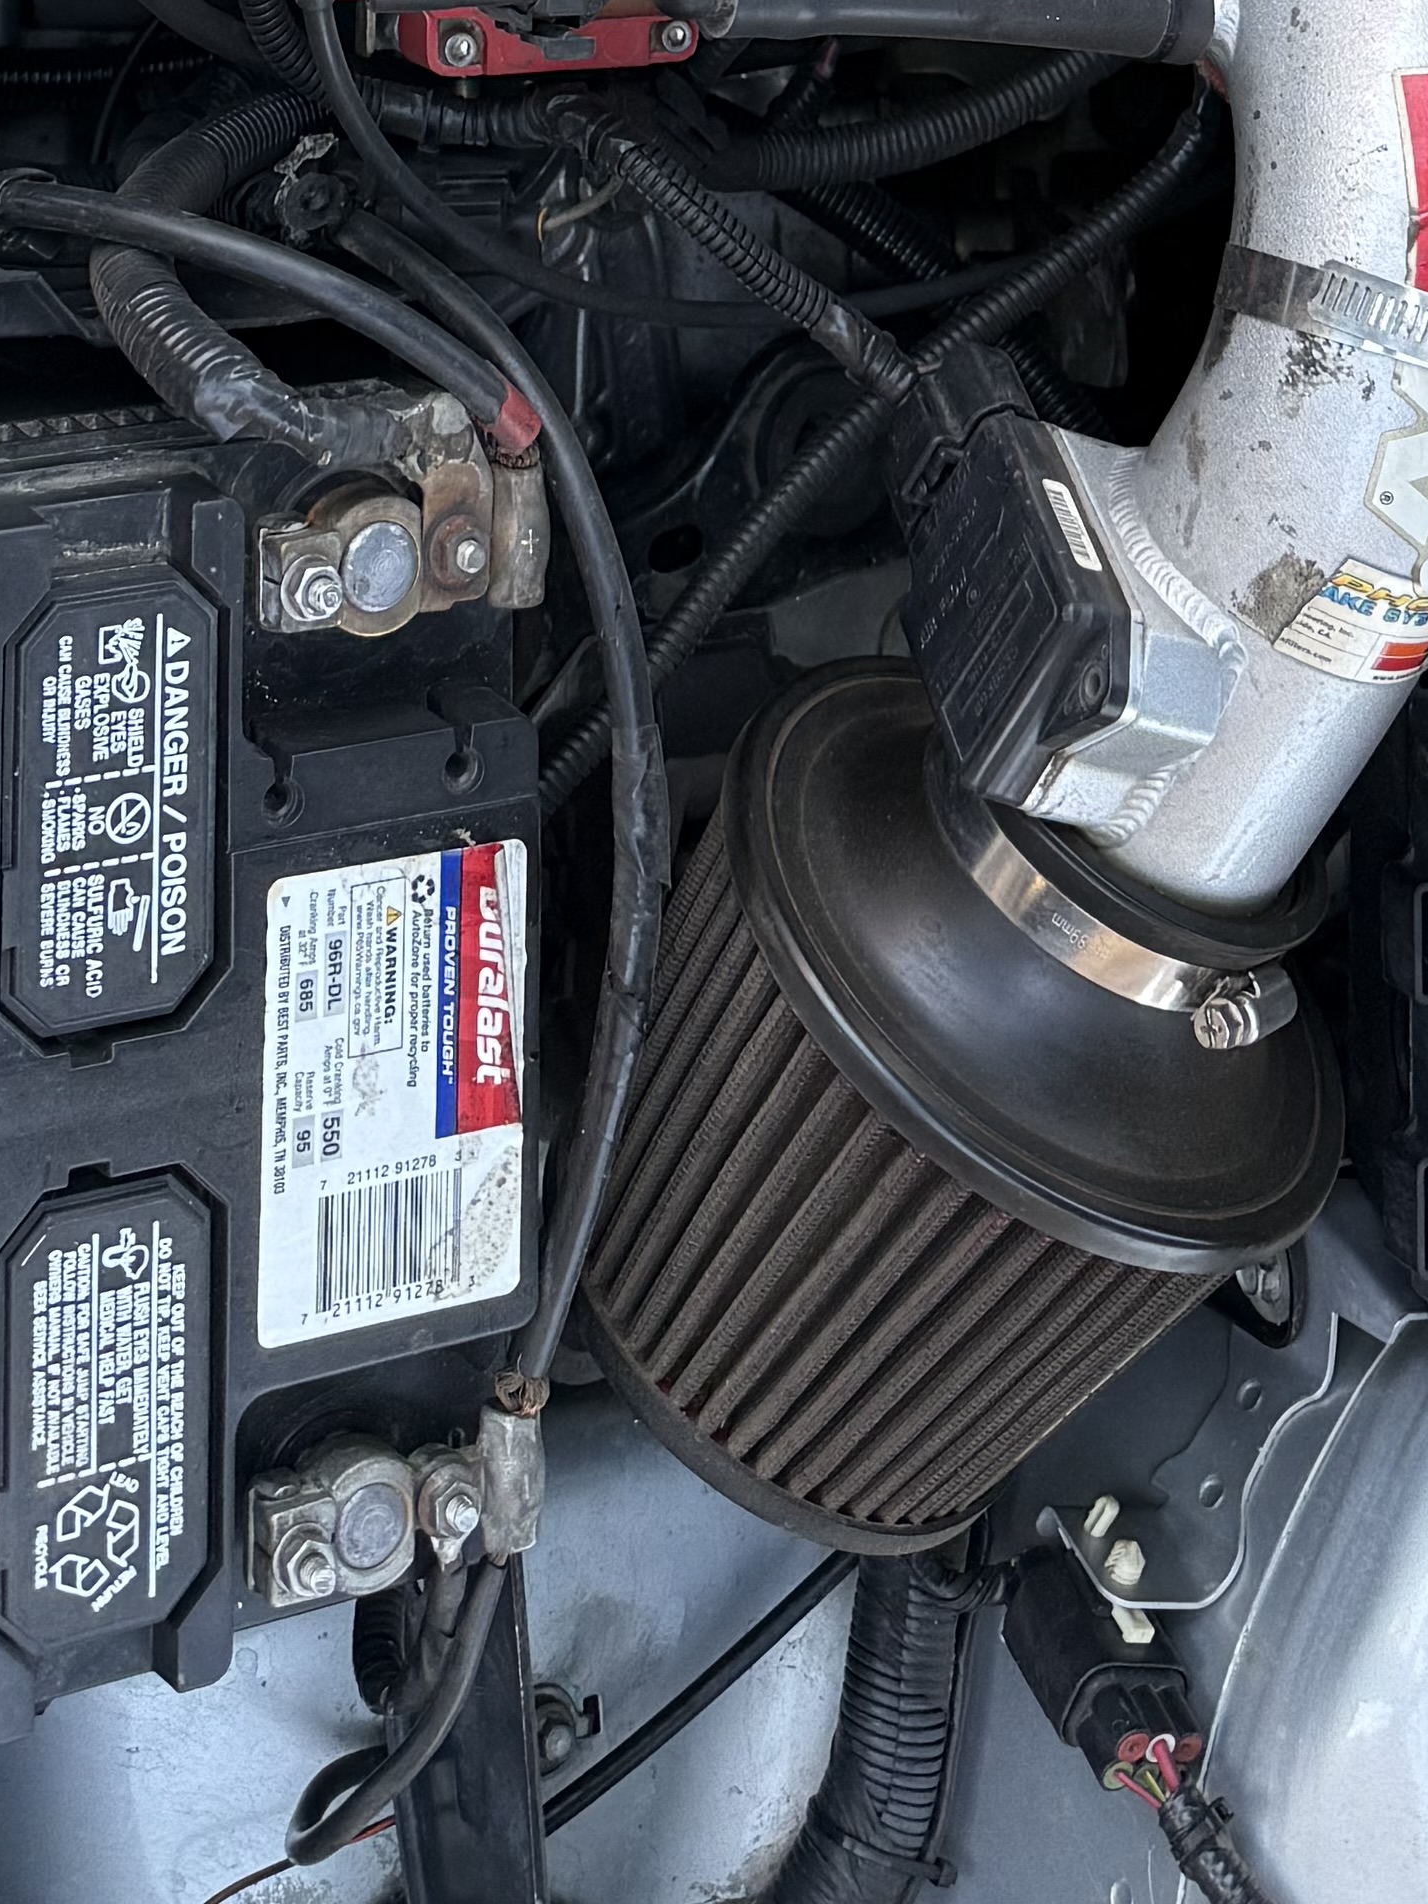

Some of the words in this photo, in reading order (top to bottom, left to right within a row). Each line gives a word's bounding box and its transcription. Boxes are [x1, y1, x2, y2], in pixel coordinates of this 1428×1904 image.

[58, 636, 73, 662] CAN
[57, 665, 72, 705] CAUSE
[74, 675, 92, 730] GASES
[41, 698, 57, 743] INJURY
[92, 673, 111, 762] EXPLOSIVE
[109, 711, 126, 754] EYES
[162, 660, 189, 797] DANGER
[56, 708, 72, 777] BLINDNESS
[127, 708, 144, 768] SHIELD
[40, 798, 56, 864] SMOKING
[56, 796, 71, 852] FLAMES
[72, 794, 87, 851] SPARKS
[88, 806, 105, 835] NO
[40, 883, 55, 938] SEVERE
[72, 877, 87, 908] CAN
[161, 832, 187, 956] POISON
[56, 880, 70, 959] BLINDNESS
[87, 874, 105, 954] SULFURIC
[337, 906, 348, 925] Part
[420, 908, 435, 948] Return
[72, 911, 86, 959] CAUSE
[410, 910, 423, 968] AutoZone
[441, 906, 456, 995] PROVEN
[40, 940, 55, 988] BURNS
[56, 964, 70, 986] OR
[278, 925, 291, 989] DISTRIBUTED
[327, 939, 343, 1011] 96R-DL
[383, 927, 398, 1024] WARNING:
[420, 953, 433, 980] used
[85, 959, 102, 998] ACID
[299, 979, 313, 1012] 685
[476, 886, 511, 1085] Duralast
[277, 1008, 289, 1032] BEST
[407, 991, 421, 1030] proper
[419, 984, 433, 1036] batteries
[274, 1035, 289, 1070] PARTS,
[293, 1072, 304, 1112] Capacity
[305, 1071, 316, 1110] Reserve
[273, 1098, 287, 1147] MEMPHIS,
[296, 1130, 310, 1153] 95
[323, 1116, 340, 1156] 550
[274, 1166, 285, 1194] 38103
[347, 1165, 389, 1185] 21112
[395, 1155, 436, 1174] 91278
[159, 1238, 172, 1259] DO
[158, 1262, 171, 1291] NOT
[172, 1264, 185, 1300] KEEP
[116, 1285, 133, 1322] WITH
[133, 1282, 150, 1327] FLUSH
[171, 1303, 185, 1332] OUT
[333, 1294, 383, 1317] 21112
[393, 1280, 444, 1303] 91278
[99, 1290, 115, 1350] MEDICAL
[76, 1333, 90, 1364] SAFE
[133, 1329, 149, 1364] EYES
[157, 1327, 170, 1362] KEEP
[171, 1337, 185, 1356] OF
[98, 1353, 115, 1388] HELP
[157, 1366, 170, 1401] VENT
[171, 1360, 184, 1389] THE
[98, 1392, 115, 1425] FAST
[115, 1377, 132, 1405] GET
[133, 1366, 149, 1456] IMMEDIATELY
[75, 1405, 90, 1468] STARTING
[157, 1406, 169, 1443] CAPS
[170, 1393, 183, 1440] REACH
[156, 1446, 169, 1488] TIGHT
[170, 1443, 183, 1462] OF
[108, 1471, 141, 1494] LEAD
[170, 1467, 185, 1536] CHILDREN
[34, 1525, 50, 1590] RECYCLE
[155, 1528, 170, 1569] LEVEL
[90, 1564, 138, 1613] RETURN
